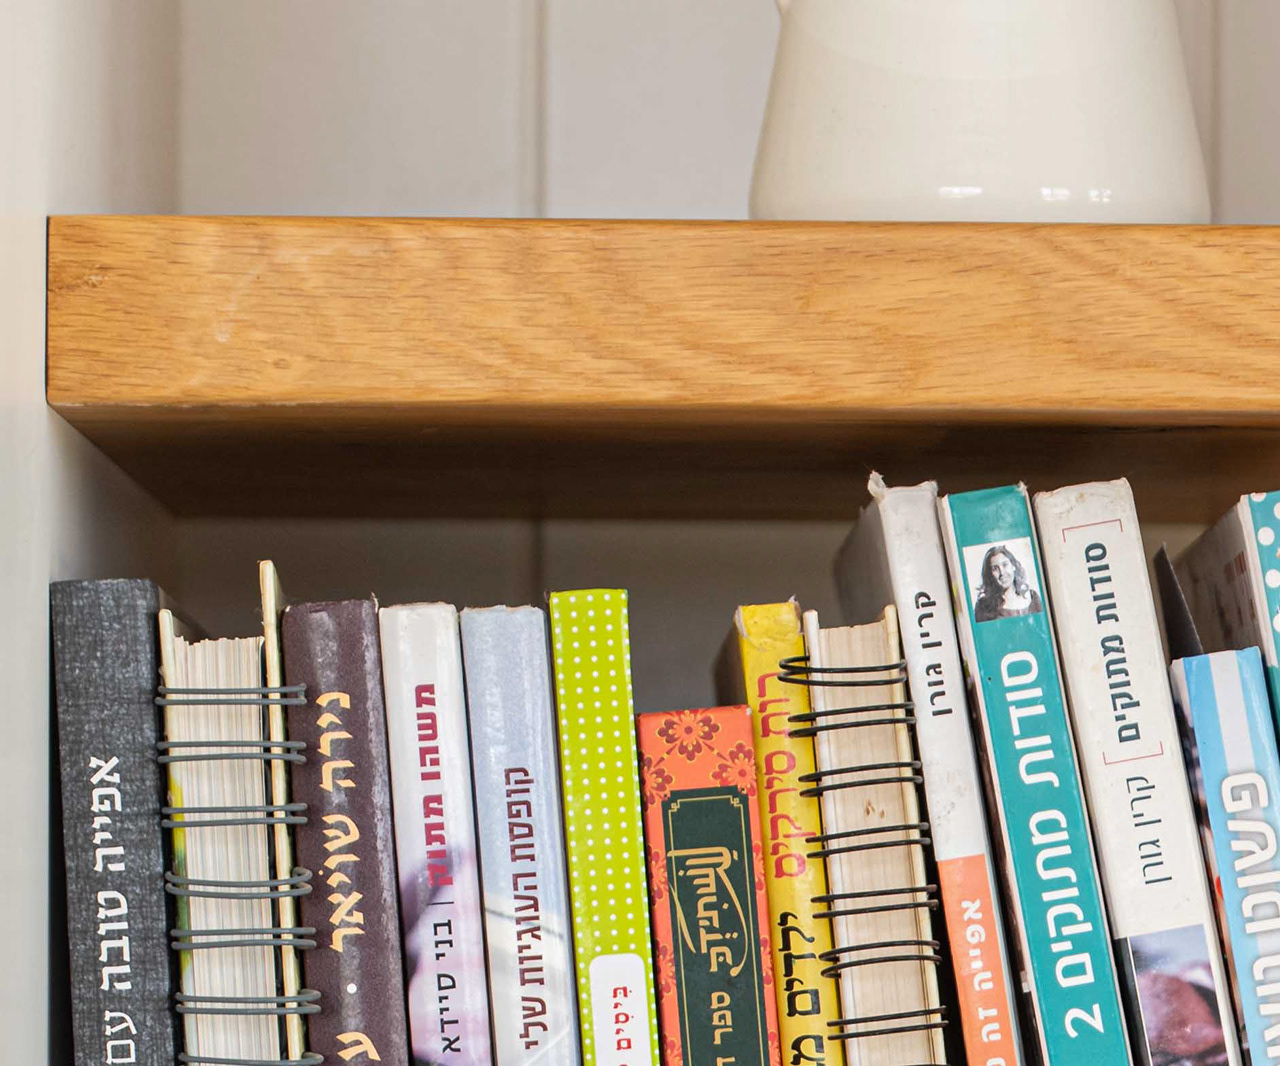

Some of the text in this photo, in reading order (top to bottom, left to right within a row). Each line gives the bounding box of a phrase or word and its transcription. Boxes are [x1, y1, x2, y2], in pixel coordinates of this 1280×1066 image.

[914, 591, 953, 716] קרין גורן
[1084, 542, 1141, 743] סודות מתוקים
[316, 691, 356, 792] נירה
[414, 684, 441, 781] משהו
[757, 672, 816, 878] רות סירקיס
[89, 756, 125, 873] אפייה
[422, 794, 454, 887] מתוק
[1000, 650, 1105, 1039] סודות מתוקים 2
[1125, 776, 1172, 885] קרין גורן
[97, 891, 132, 991] טובה
[434, 919, 454, 962] בני
[504, 767, 548, 1049] קופסת העוגיות שלי
[436, 972, 461, 1053] סיידא
[710, 990, 733, 1044] ספר
[779, 911, 819, 1017] ילדים
[961, 898, 994, 990] אפייה
[979, 1007, 1002, 1042] זה
[105, 1011, 138, 1063] עם
